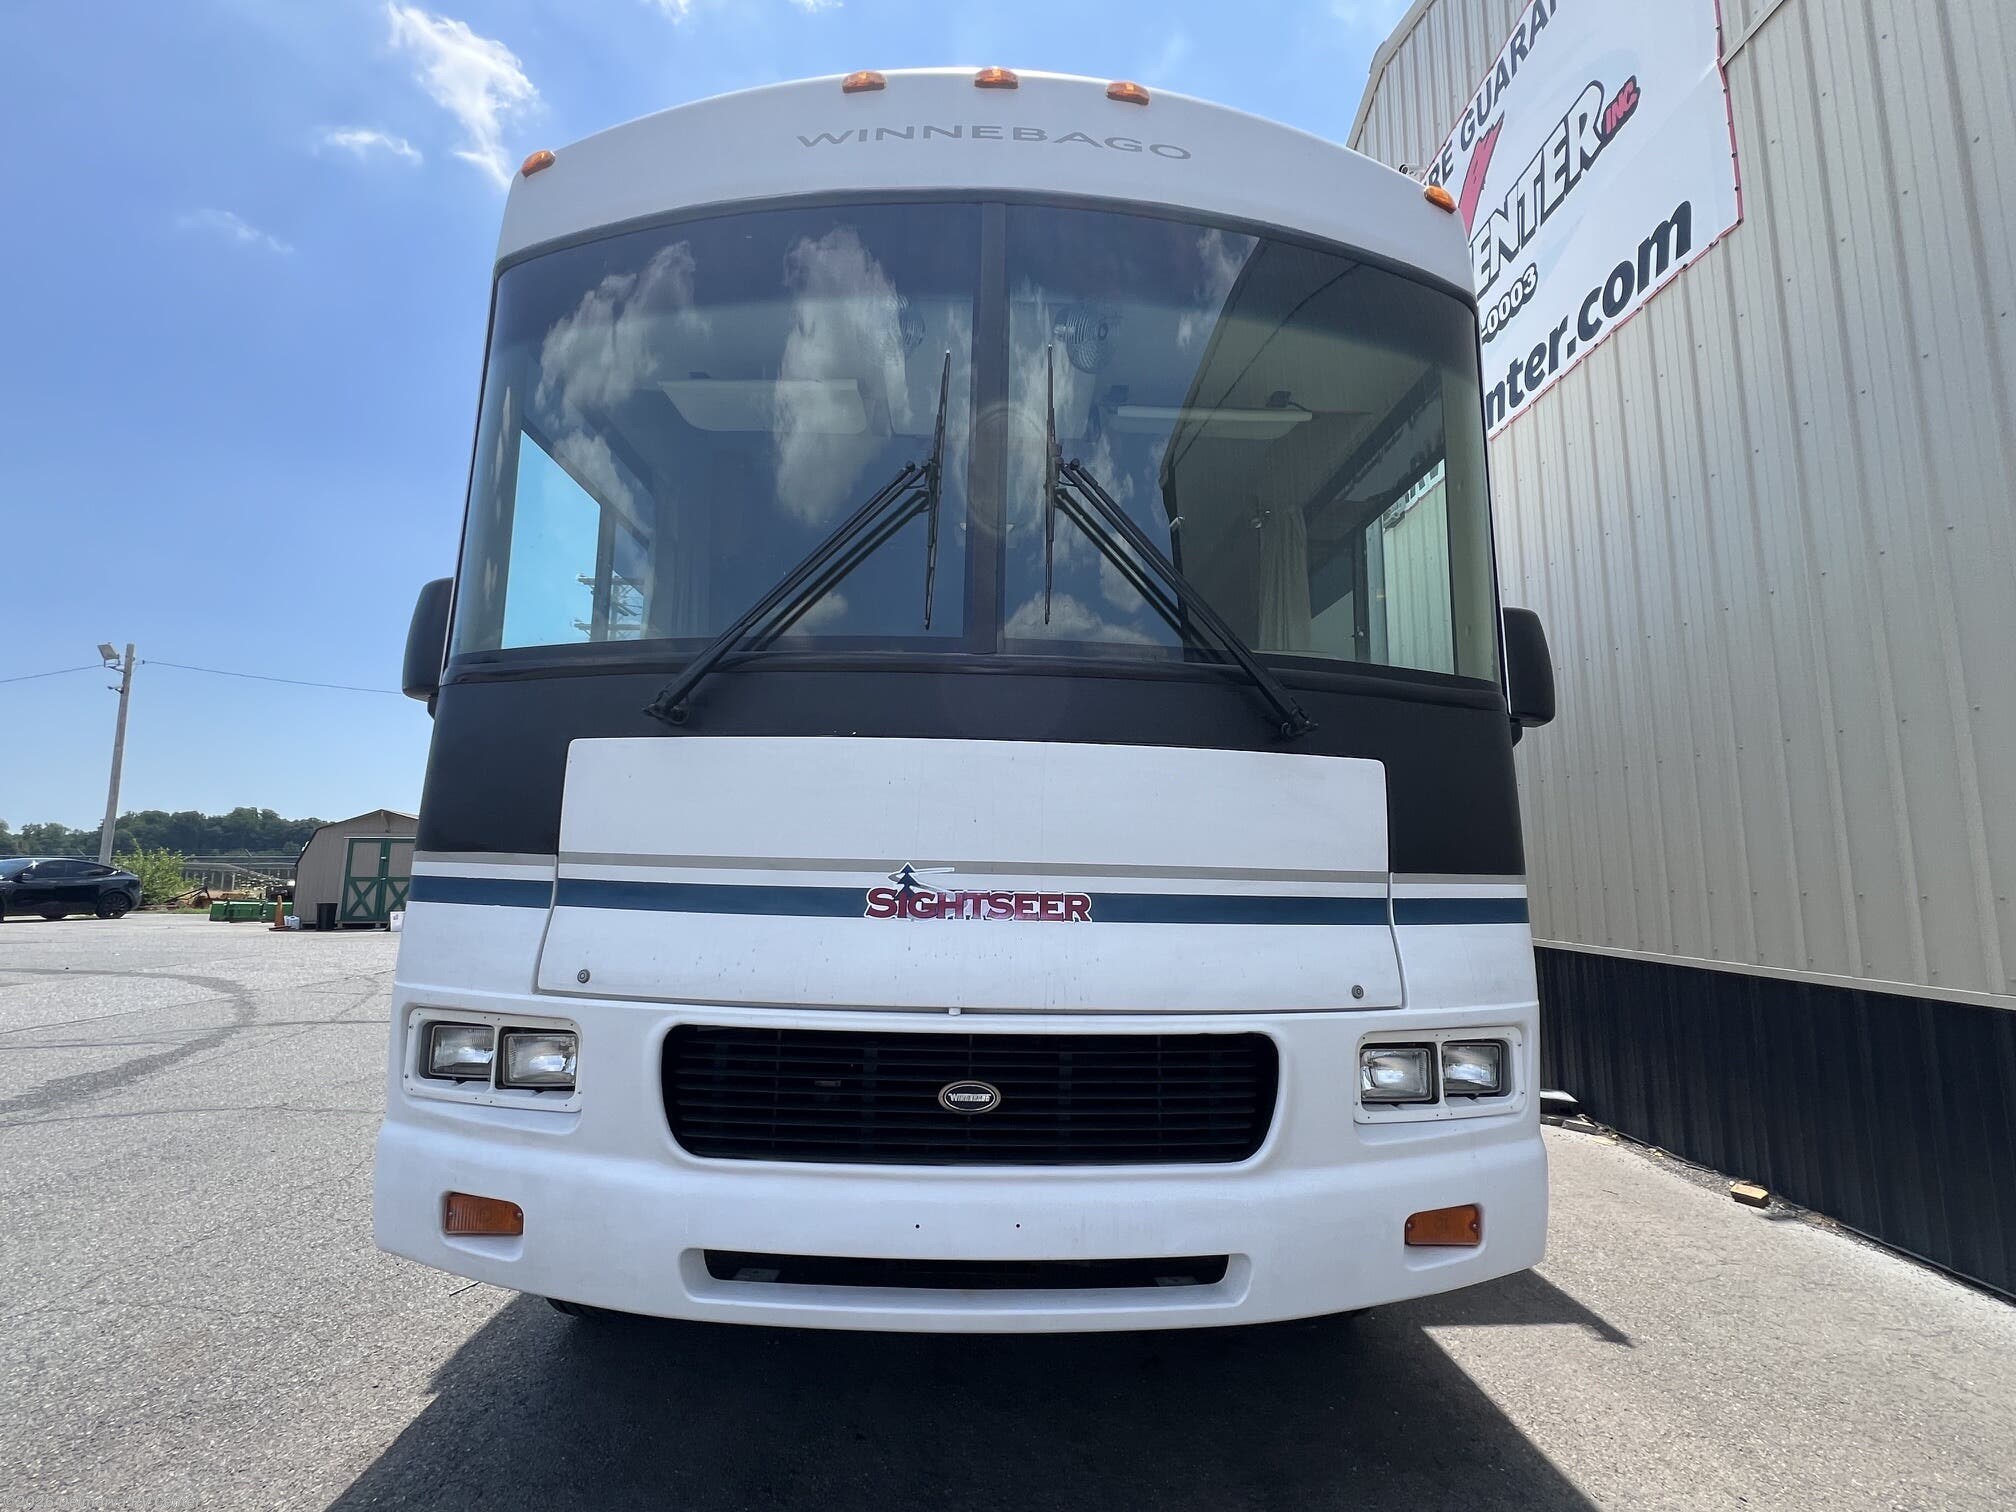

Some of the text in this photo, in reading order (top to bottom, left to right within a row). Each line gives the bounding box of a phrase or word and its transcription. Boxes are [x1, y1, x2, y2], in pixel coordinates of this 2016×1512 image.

[797, 125, 1192, 160] WINNEBAGO
[1424, 140, 1454, 188] RE
[1470, 80, 1604, 301] ENTER
[1486, 200, 1692, 430] nter.com
[865, 886, 1093, 922] SIGHTSEER
